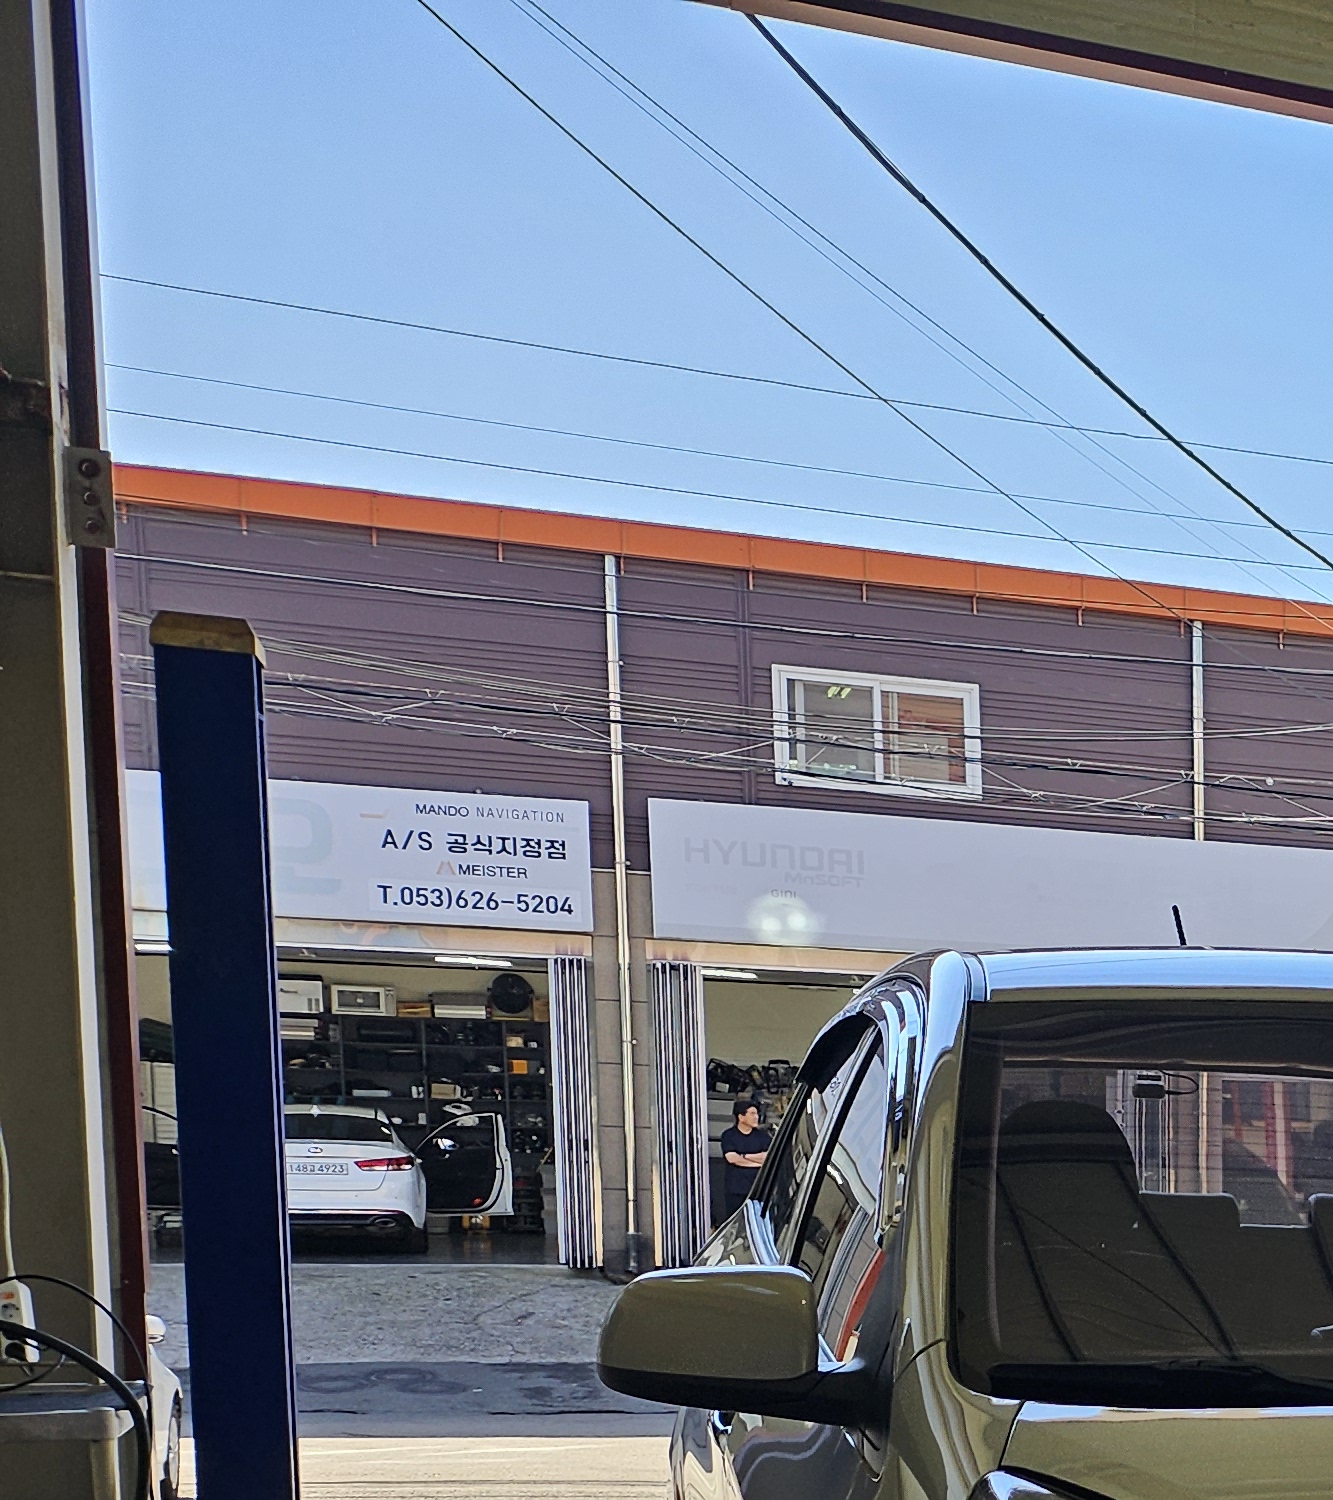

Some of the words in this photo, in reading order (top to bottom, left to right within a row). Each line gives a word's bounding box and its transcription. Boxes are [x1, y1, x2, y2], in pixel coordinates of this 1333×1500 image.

[415, 803, 470, 818] MANDO
[476, 806, 565, 824] NAVIGATION
[381, 829, 433, 851] A/S
[445, 832, 568, 861] 공식지정점
[684, 837, 865, 875] HYUNDAI
[458, 863, 528, 880] MEISTER
[377, 883, 574, 915] T.053)626-5204
